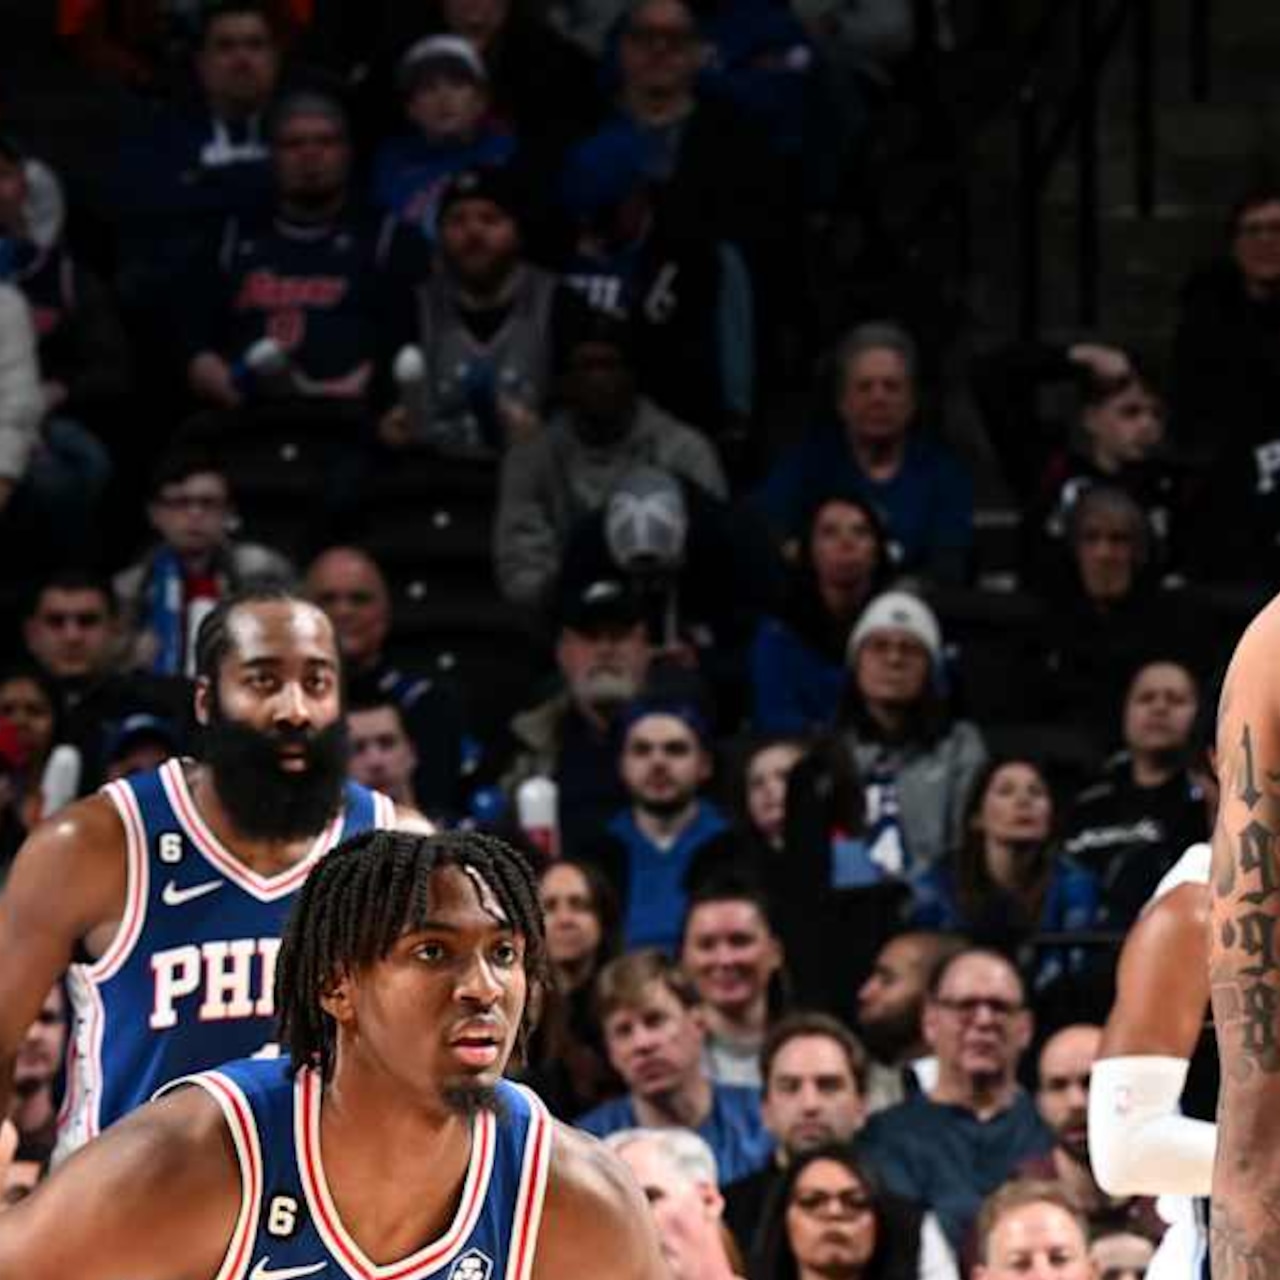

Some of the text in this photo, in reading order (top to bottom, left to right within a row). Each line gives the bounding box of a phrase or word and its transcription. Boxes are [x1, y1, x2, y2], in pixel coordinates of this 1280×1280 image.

[158, 831, 183, 864] 6
[148, 937, 283, 1031] PHI
[268, 1197, 297, 1236] 6
